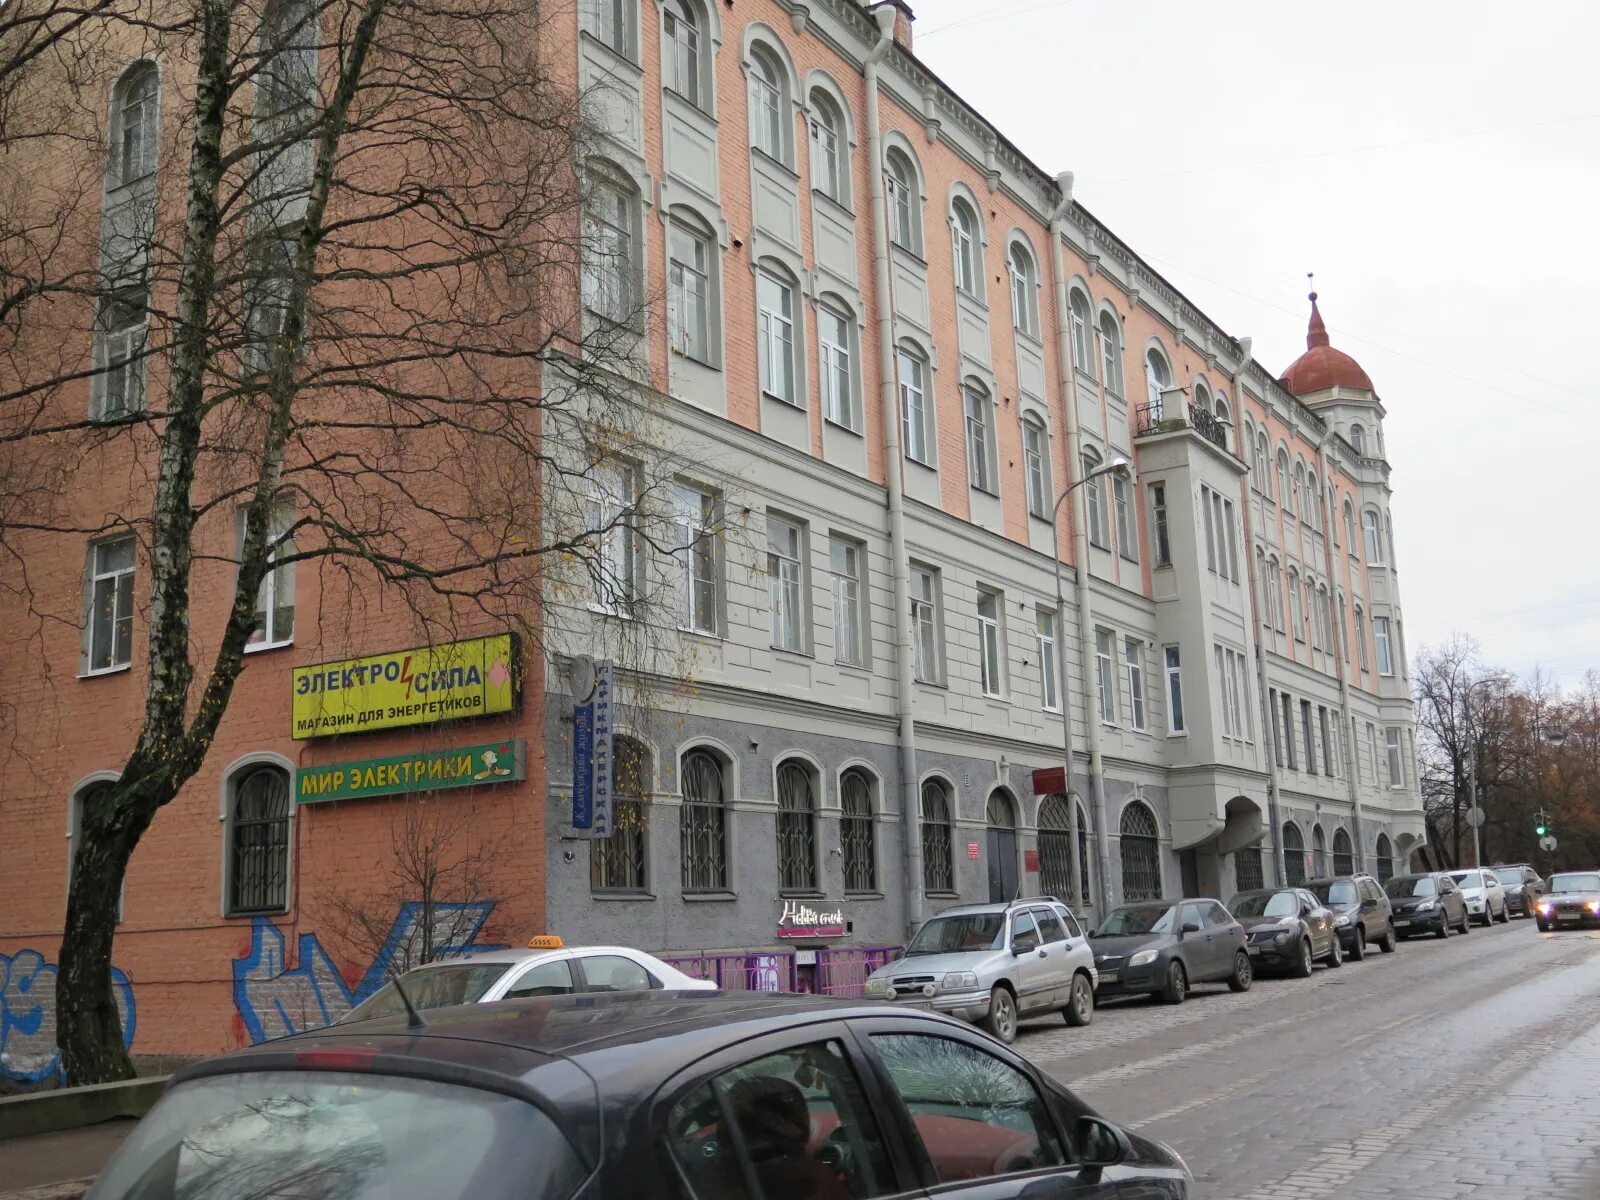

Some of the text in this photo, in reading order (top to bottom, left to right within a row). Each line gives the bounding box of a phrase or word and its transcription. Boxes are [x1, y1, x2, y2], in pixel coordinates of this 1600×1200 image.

[297, 661, 481, 695] ЭЛЕКТРО СИЛА
[297, 695, 482, 731] МАГАЗИН ДЛЯ ЭНЕРГЕТИКОВ
[595, 665, 608, 834] ПАРИКМАХЕРСКАЯ
[301, 754, 473, 795] МИР ЭЛЕКТРИКИ
